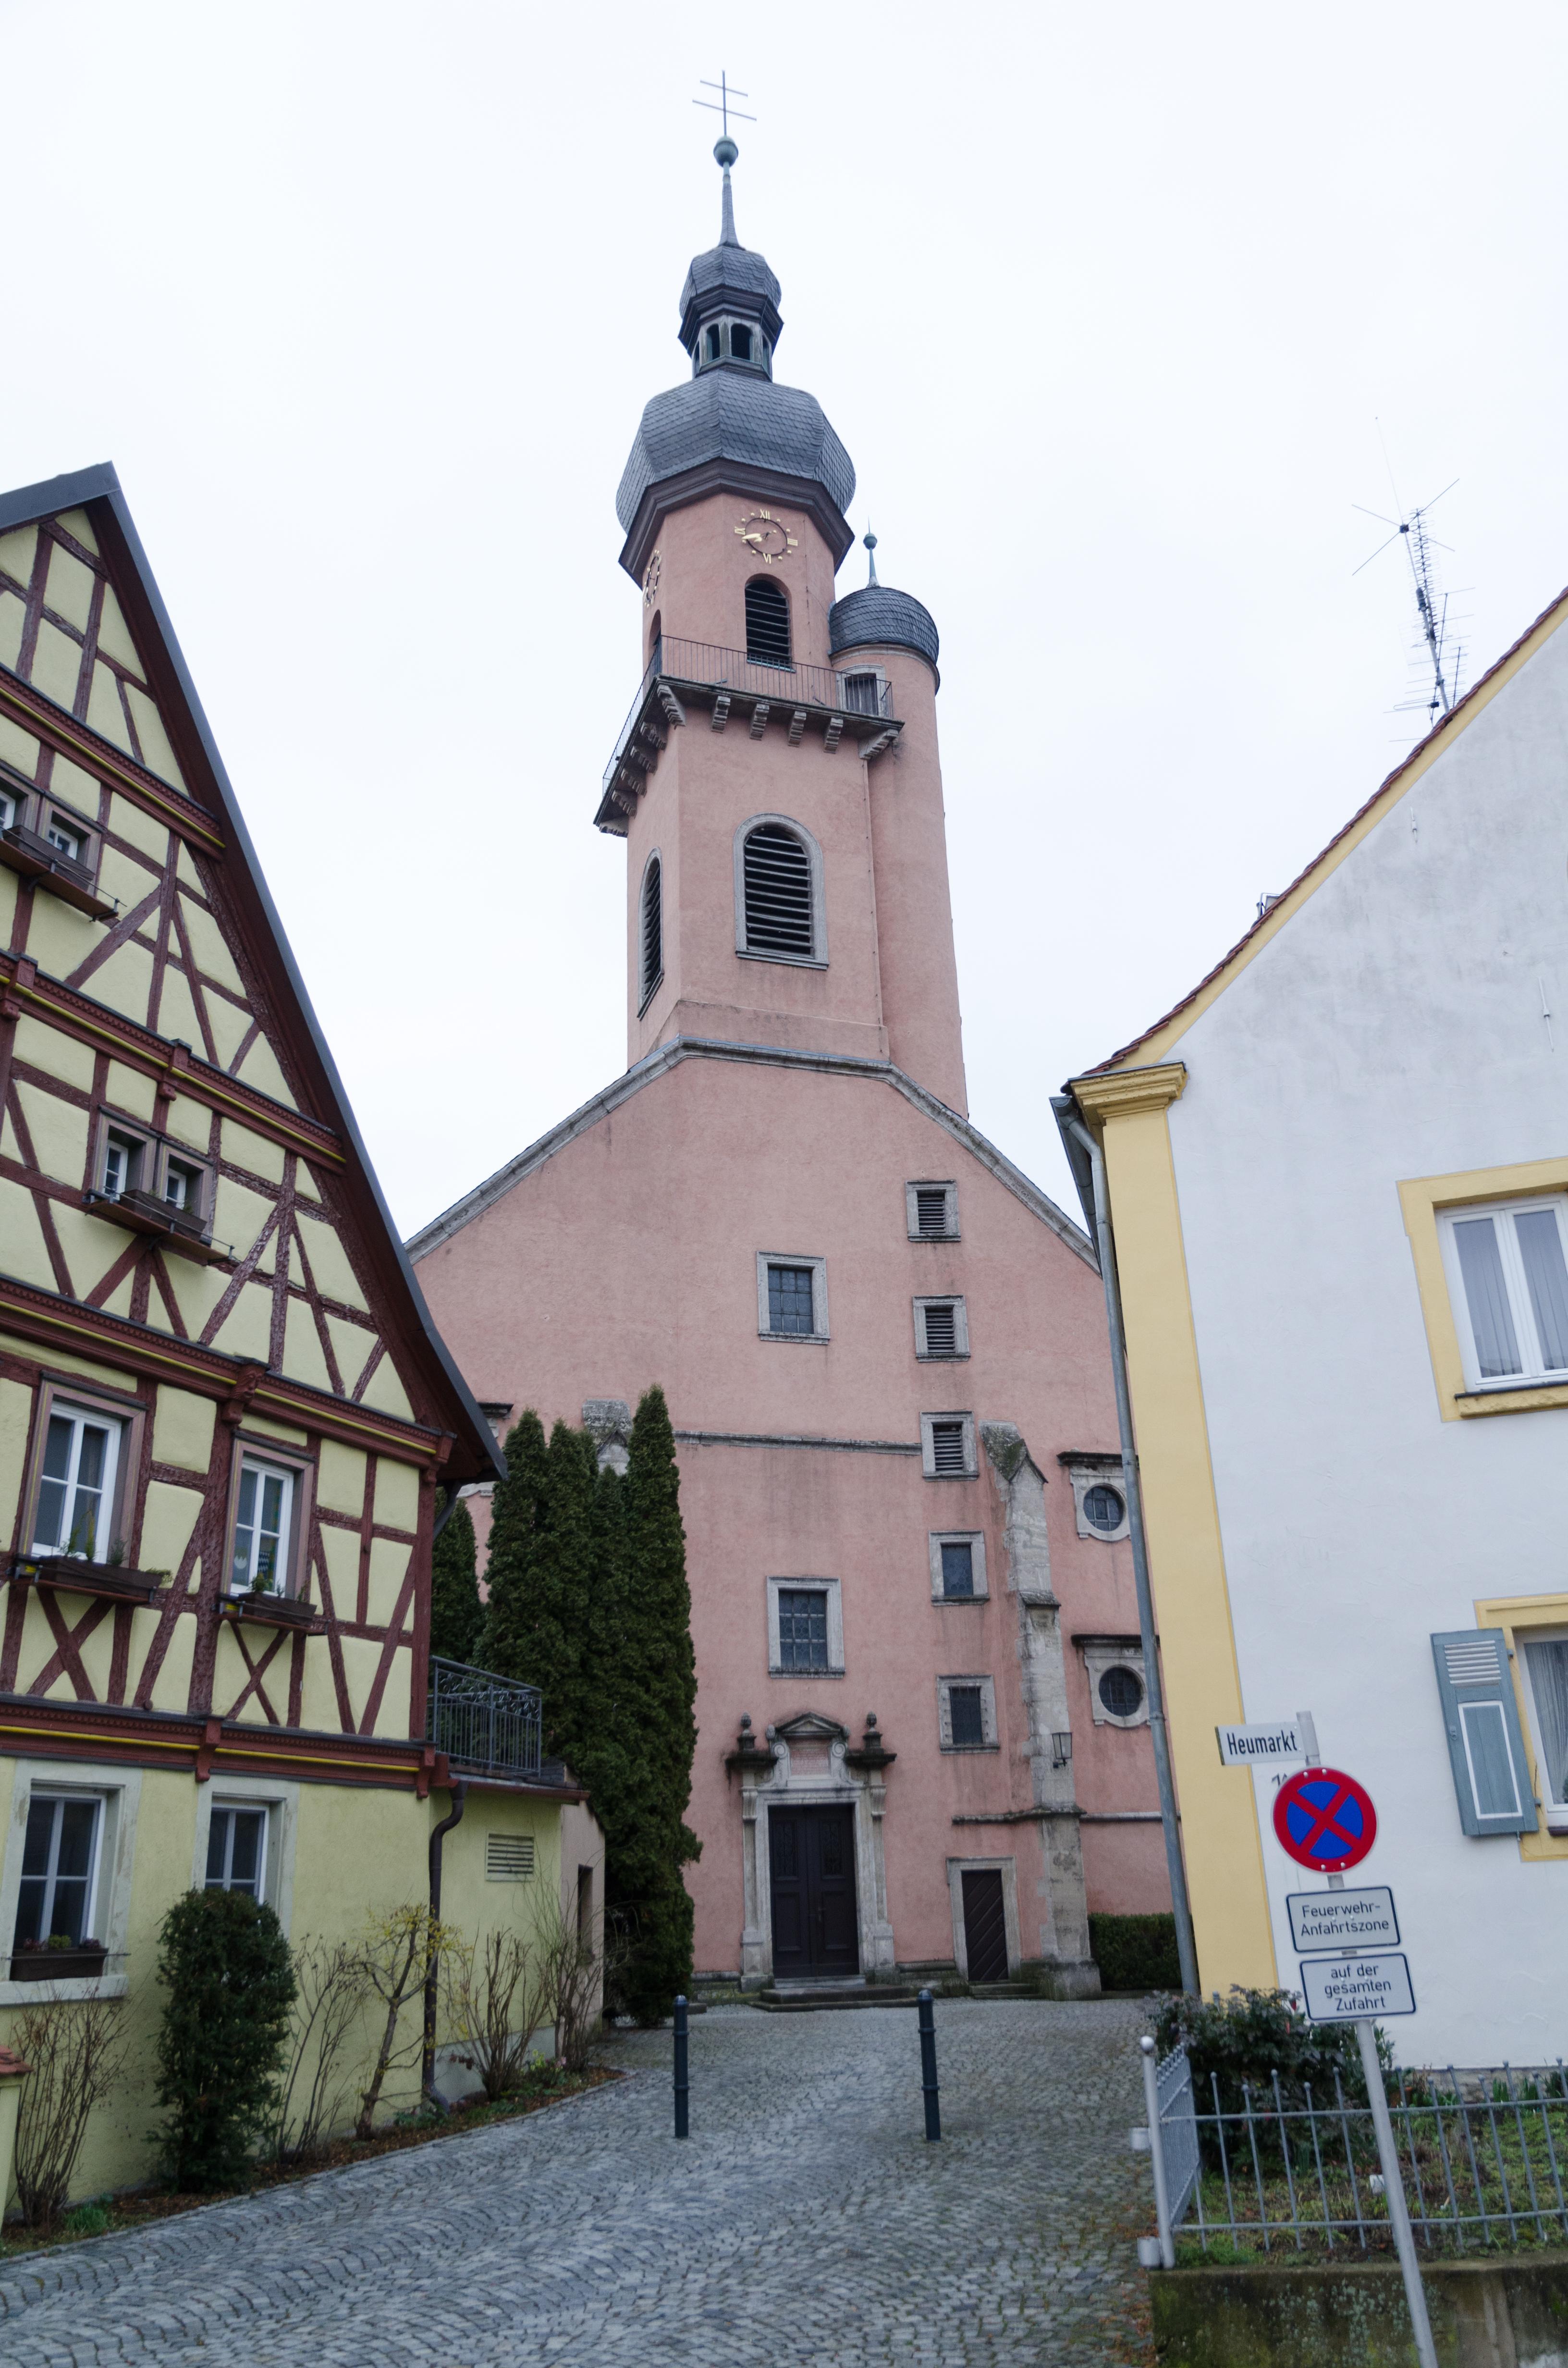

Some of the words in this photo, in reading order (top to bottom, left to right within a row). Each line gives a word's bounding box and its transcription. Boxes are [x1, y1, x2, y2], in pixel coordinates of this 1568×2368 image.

[760, 508, 770, 520] XII
[763, 553, 772, 564] VI
[1226, 1729, 1298, 1755] Heumarkt
[1302, 1901, 1380, 1918] Feuerwehr-
[1301, 1920, 1389, 1936] Anfahrtszone
[1331, 1964, 1351, 1979] auf
[1357, 1963, 1379, 1976] der
[1324, 1980, 1391, 1998] gesamten
[1335, 1995, 1386, 2011] Zufahrt
